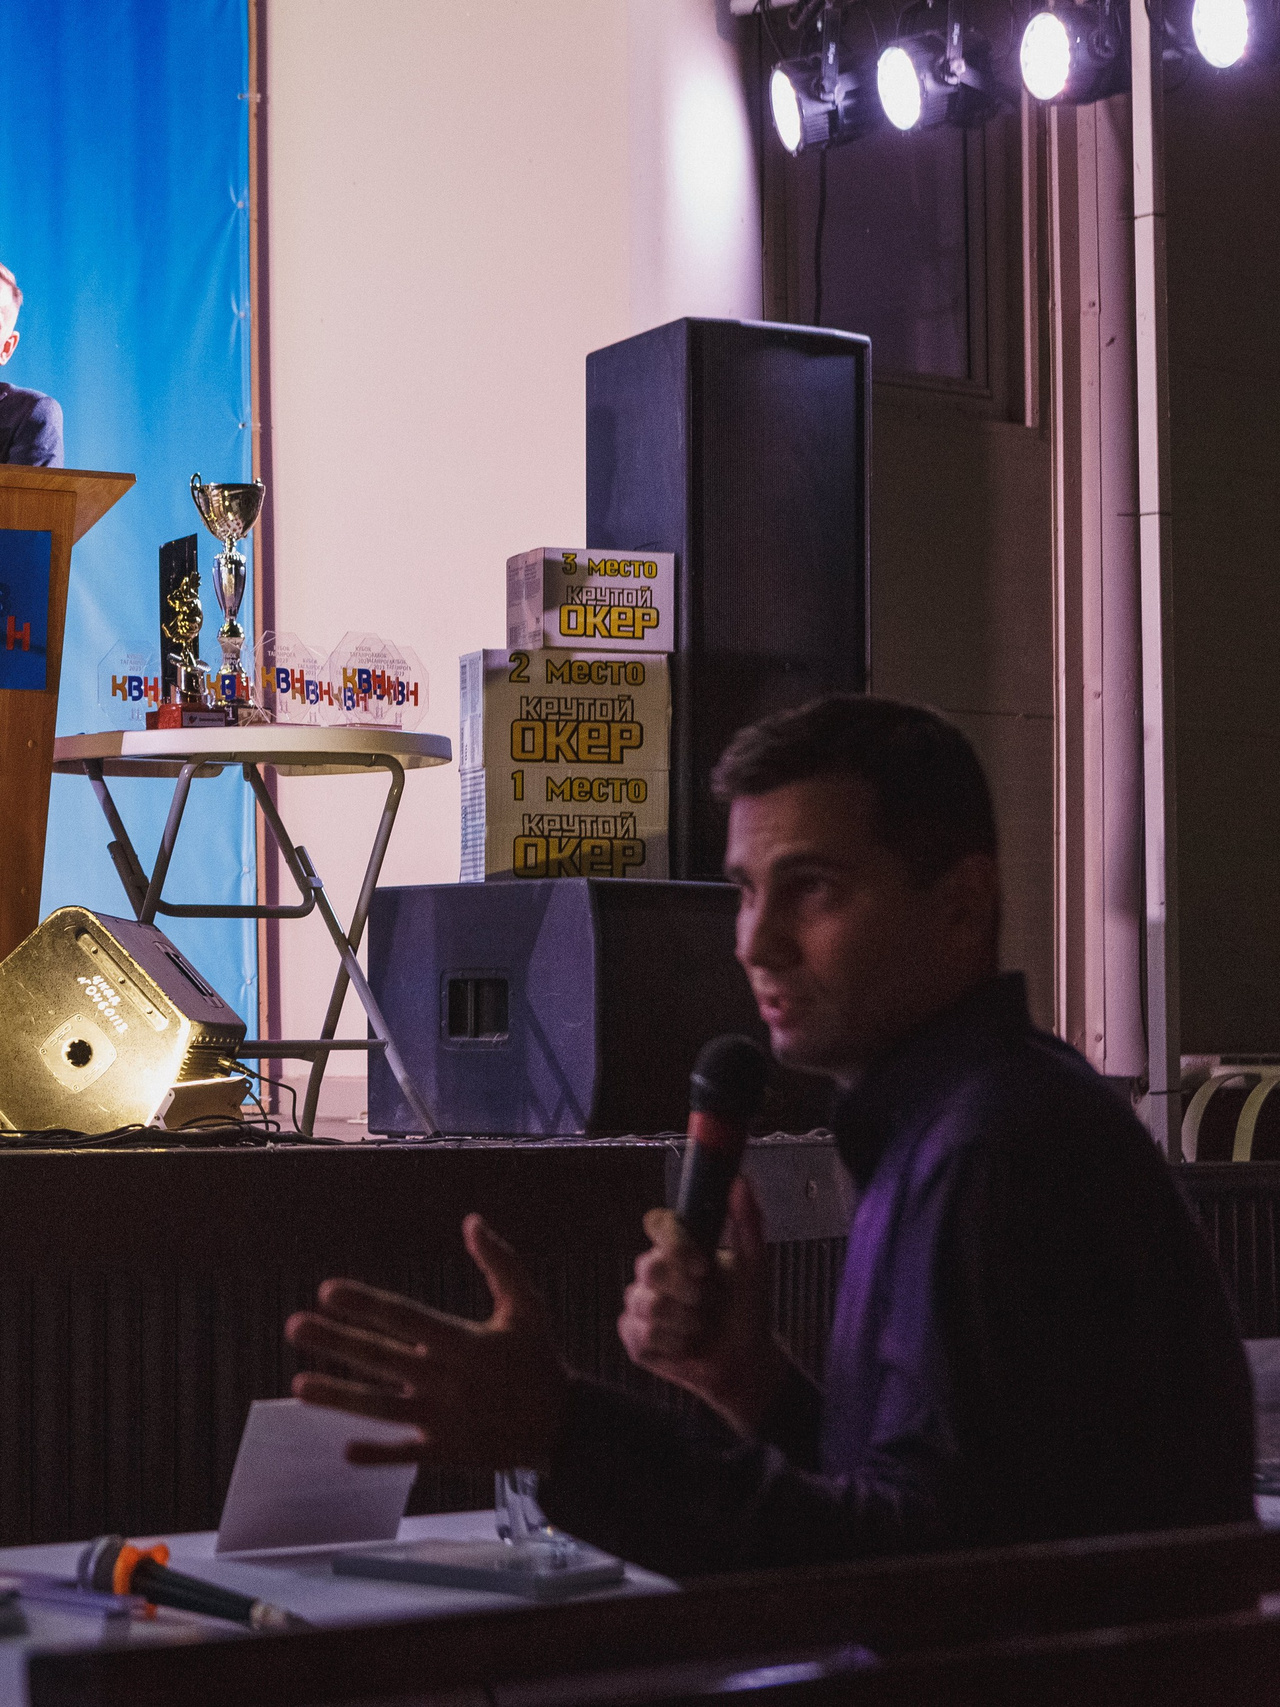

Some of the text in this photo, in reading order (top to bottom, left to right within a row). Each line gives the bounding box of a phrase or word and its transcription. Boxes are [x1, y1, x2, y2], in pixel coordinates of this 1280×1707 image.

[562, 553, 577, 576] 3
[566, 585, 653, 608] КРУТОЙ
[261, 666, 305, 695] КВН
[342, 667, 387, 697] КВН
[509, 652, 530, 684] 2
[111, 674, 159, 702] КВН
[521, 694, 635, 722] КРУТОЙ
[511, 769, 525, 802] 1
[521, 811, 637, 839] КРУТОЙ
